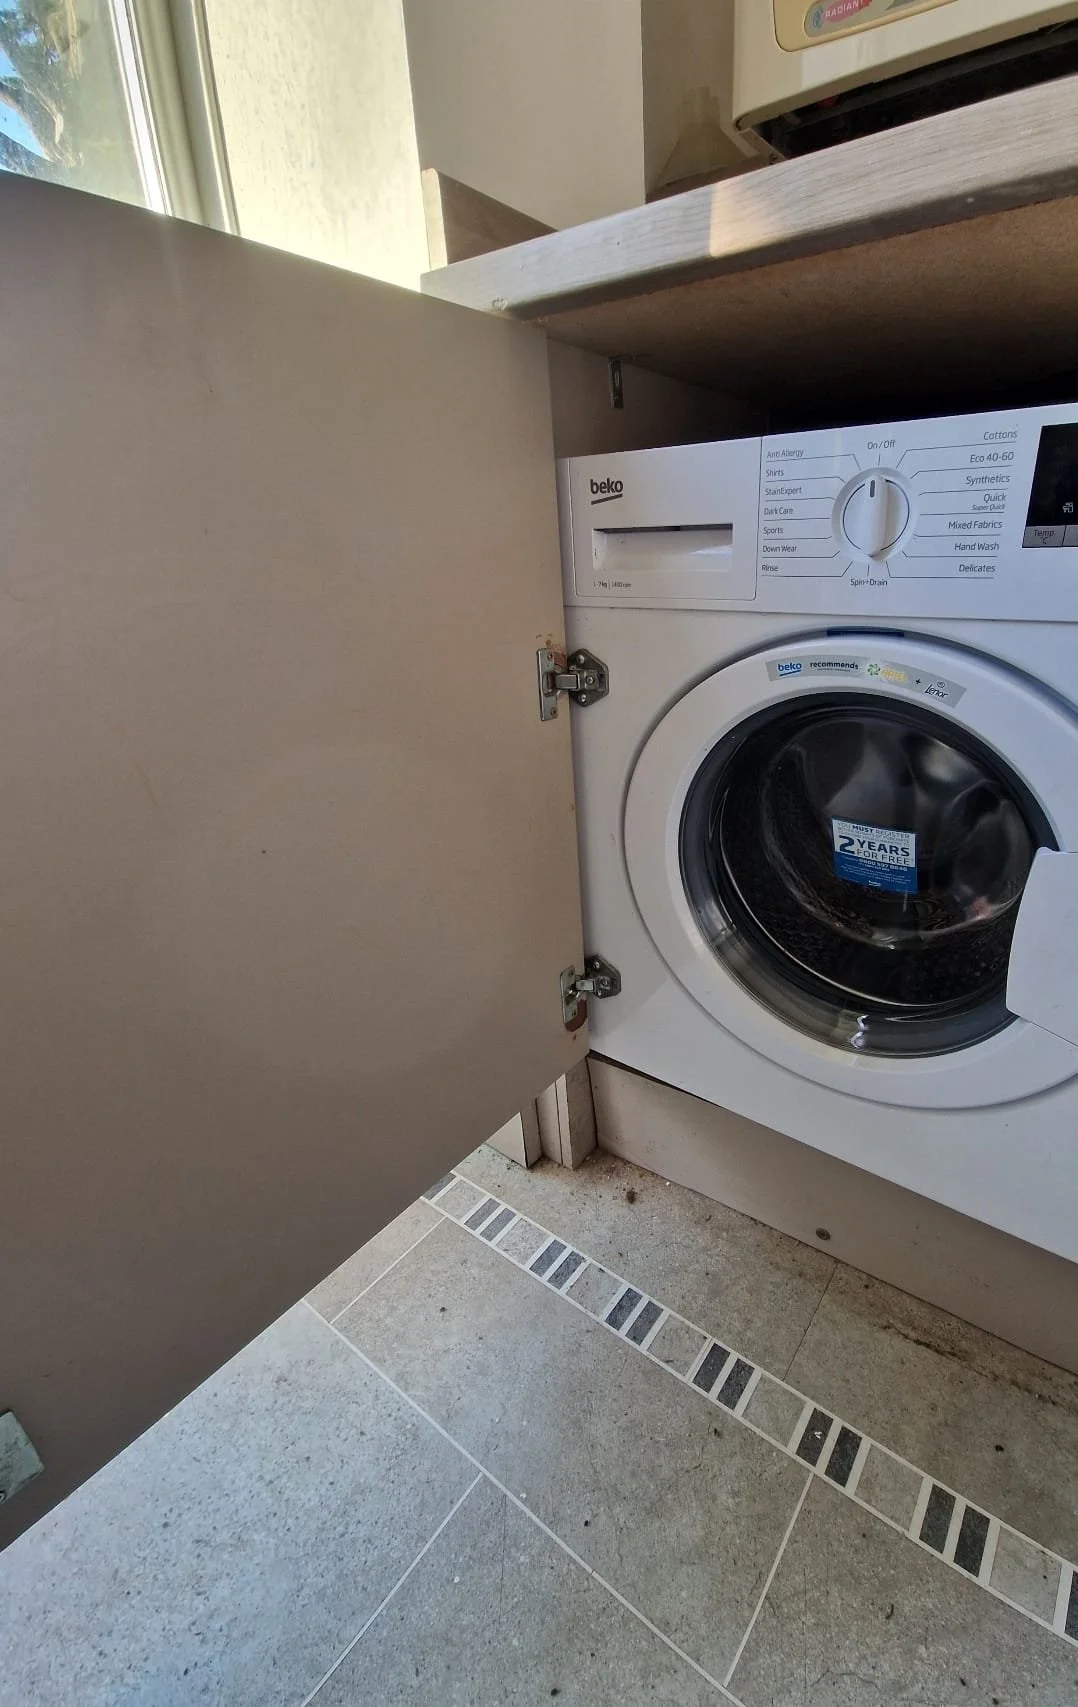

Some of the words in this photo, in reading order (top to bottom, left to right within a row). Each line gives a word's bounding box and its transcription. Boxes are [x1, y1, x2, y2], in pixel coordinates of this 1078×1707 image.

[983, 430, 1018, 441] Cottons
[867, 441, 878, 450] On
[884, 440, 896, 449] Off
[781, 449, 804, 458] Allergy
[969, 454, 985, 463] Eco
[986, 451, 1015, 462] 40-60
[765, 469, 785, 477] Shirts
[590, 477, 624, 494] beko
[965, 475, 1011, 487] Synthetics
[765, 487, 802, 497] StainExpert
[983, 492, 1007, 503] Quick
[763, 507, 779, 516] Dark
[779, 507, 794, 515] Care
[989, 503, 1005, 511] Quick
[948, 521, 972, 530] Mixed
[973, 520, 1003, 529] Fabrics
[763, 526, 784, 535] Sports
[762, 545, 780, 553] Down
[781, 545, 797, 553] Wear
[954, 542, 976, 551] Hand
[977, 541, 1000, 551] Wash
[761, 564, 779, 572] Rinse
[958, 563, 996, 573] Delicates
[777, 662, 802, 673] beko
[809, 661, 859, 671] recommends
[924, 684, 949, 699] Lenor
[852, 824, 874, 833] MUST
[838, 834, 855, 854] 2
[856, 838, 910, 857] YEARS
[856, 848, 878, 859] FOR
[881, 853, 910, 865] FREE
